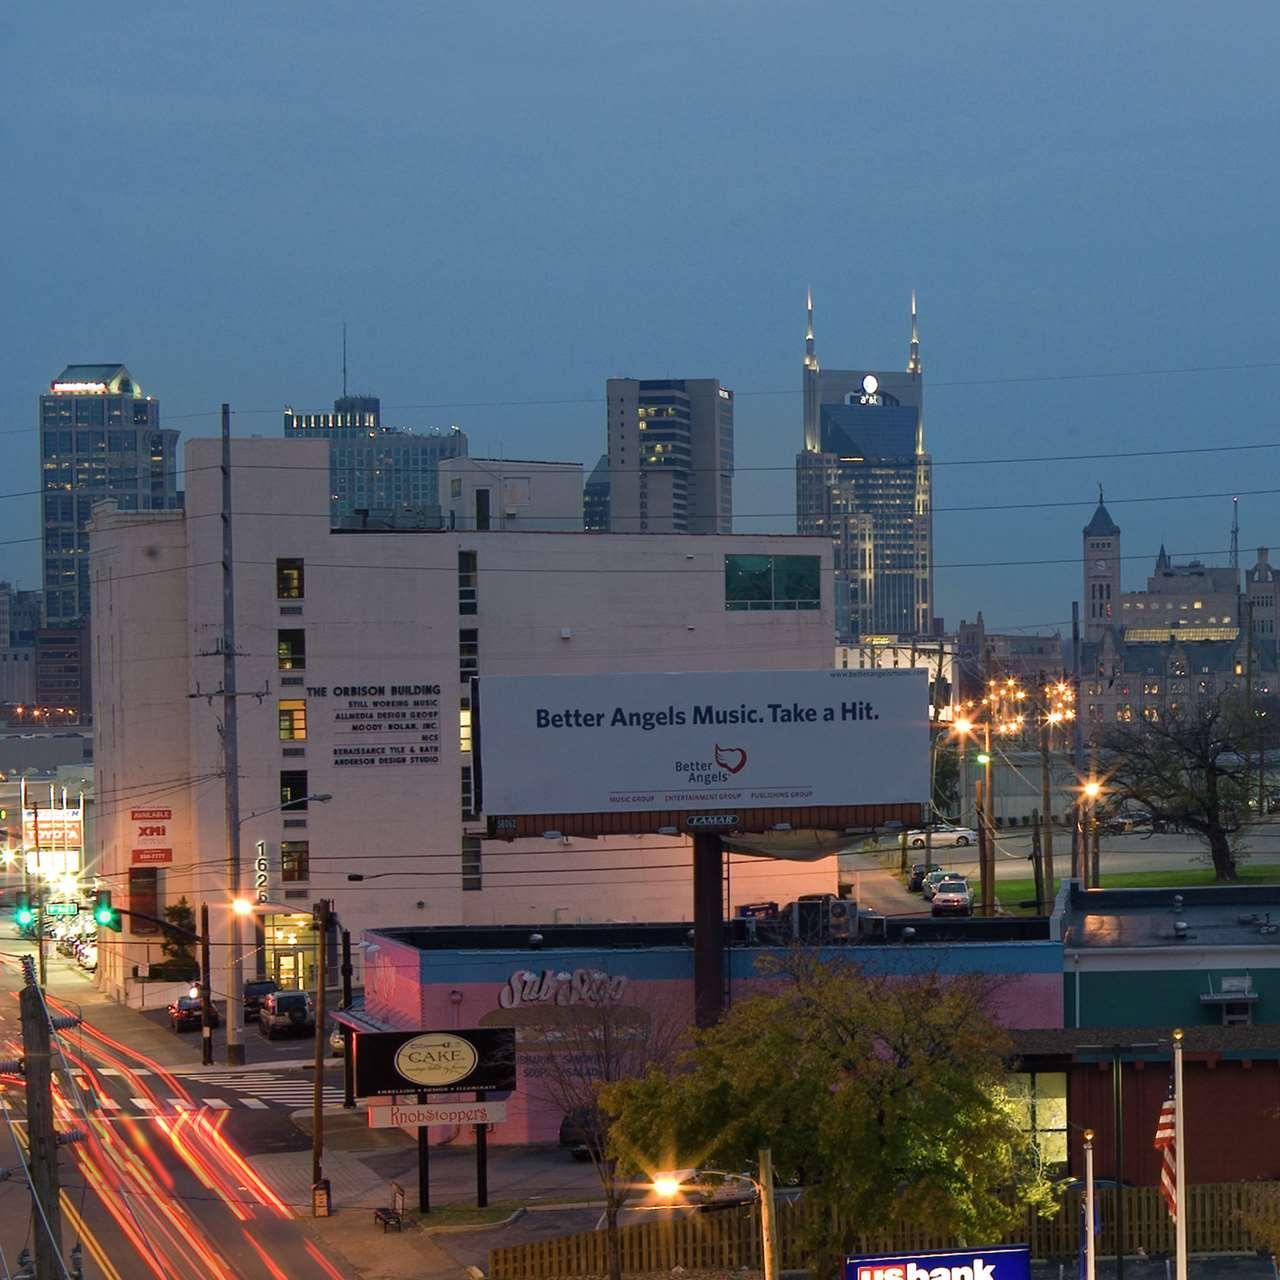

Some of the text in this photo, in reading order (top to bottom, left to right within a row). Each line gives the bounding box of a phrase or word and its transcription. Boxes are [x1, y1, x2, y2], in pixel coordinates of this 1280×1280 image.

[306, 685, 441, 697] THE ORBISON BUILDING
[372, 700, 409, 708] WORKING
[336, 712, 374, 720] ALLMEDIA
[410, 711, 438, 719] GROUP
[536, 702, 879, 731] Better Angels Music. Take a Hit.
[333, 747, 385, 755] RENAISSANCE
[675, 761, 712, 771] Better
[688, 772, 728, 785] Angels
[610, 795, 631, 803] MUSIC
[665, 794, 718, 802] ENTERTAINMENT
[751, 791, 789, 799] PUBLISHING
[692, 816, 734, 824] LAMAR
[408, 1050, 462, 1063] CAKE
[391, 1107, 488, 1126] KnobStoppers
